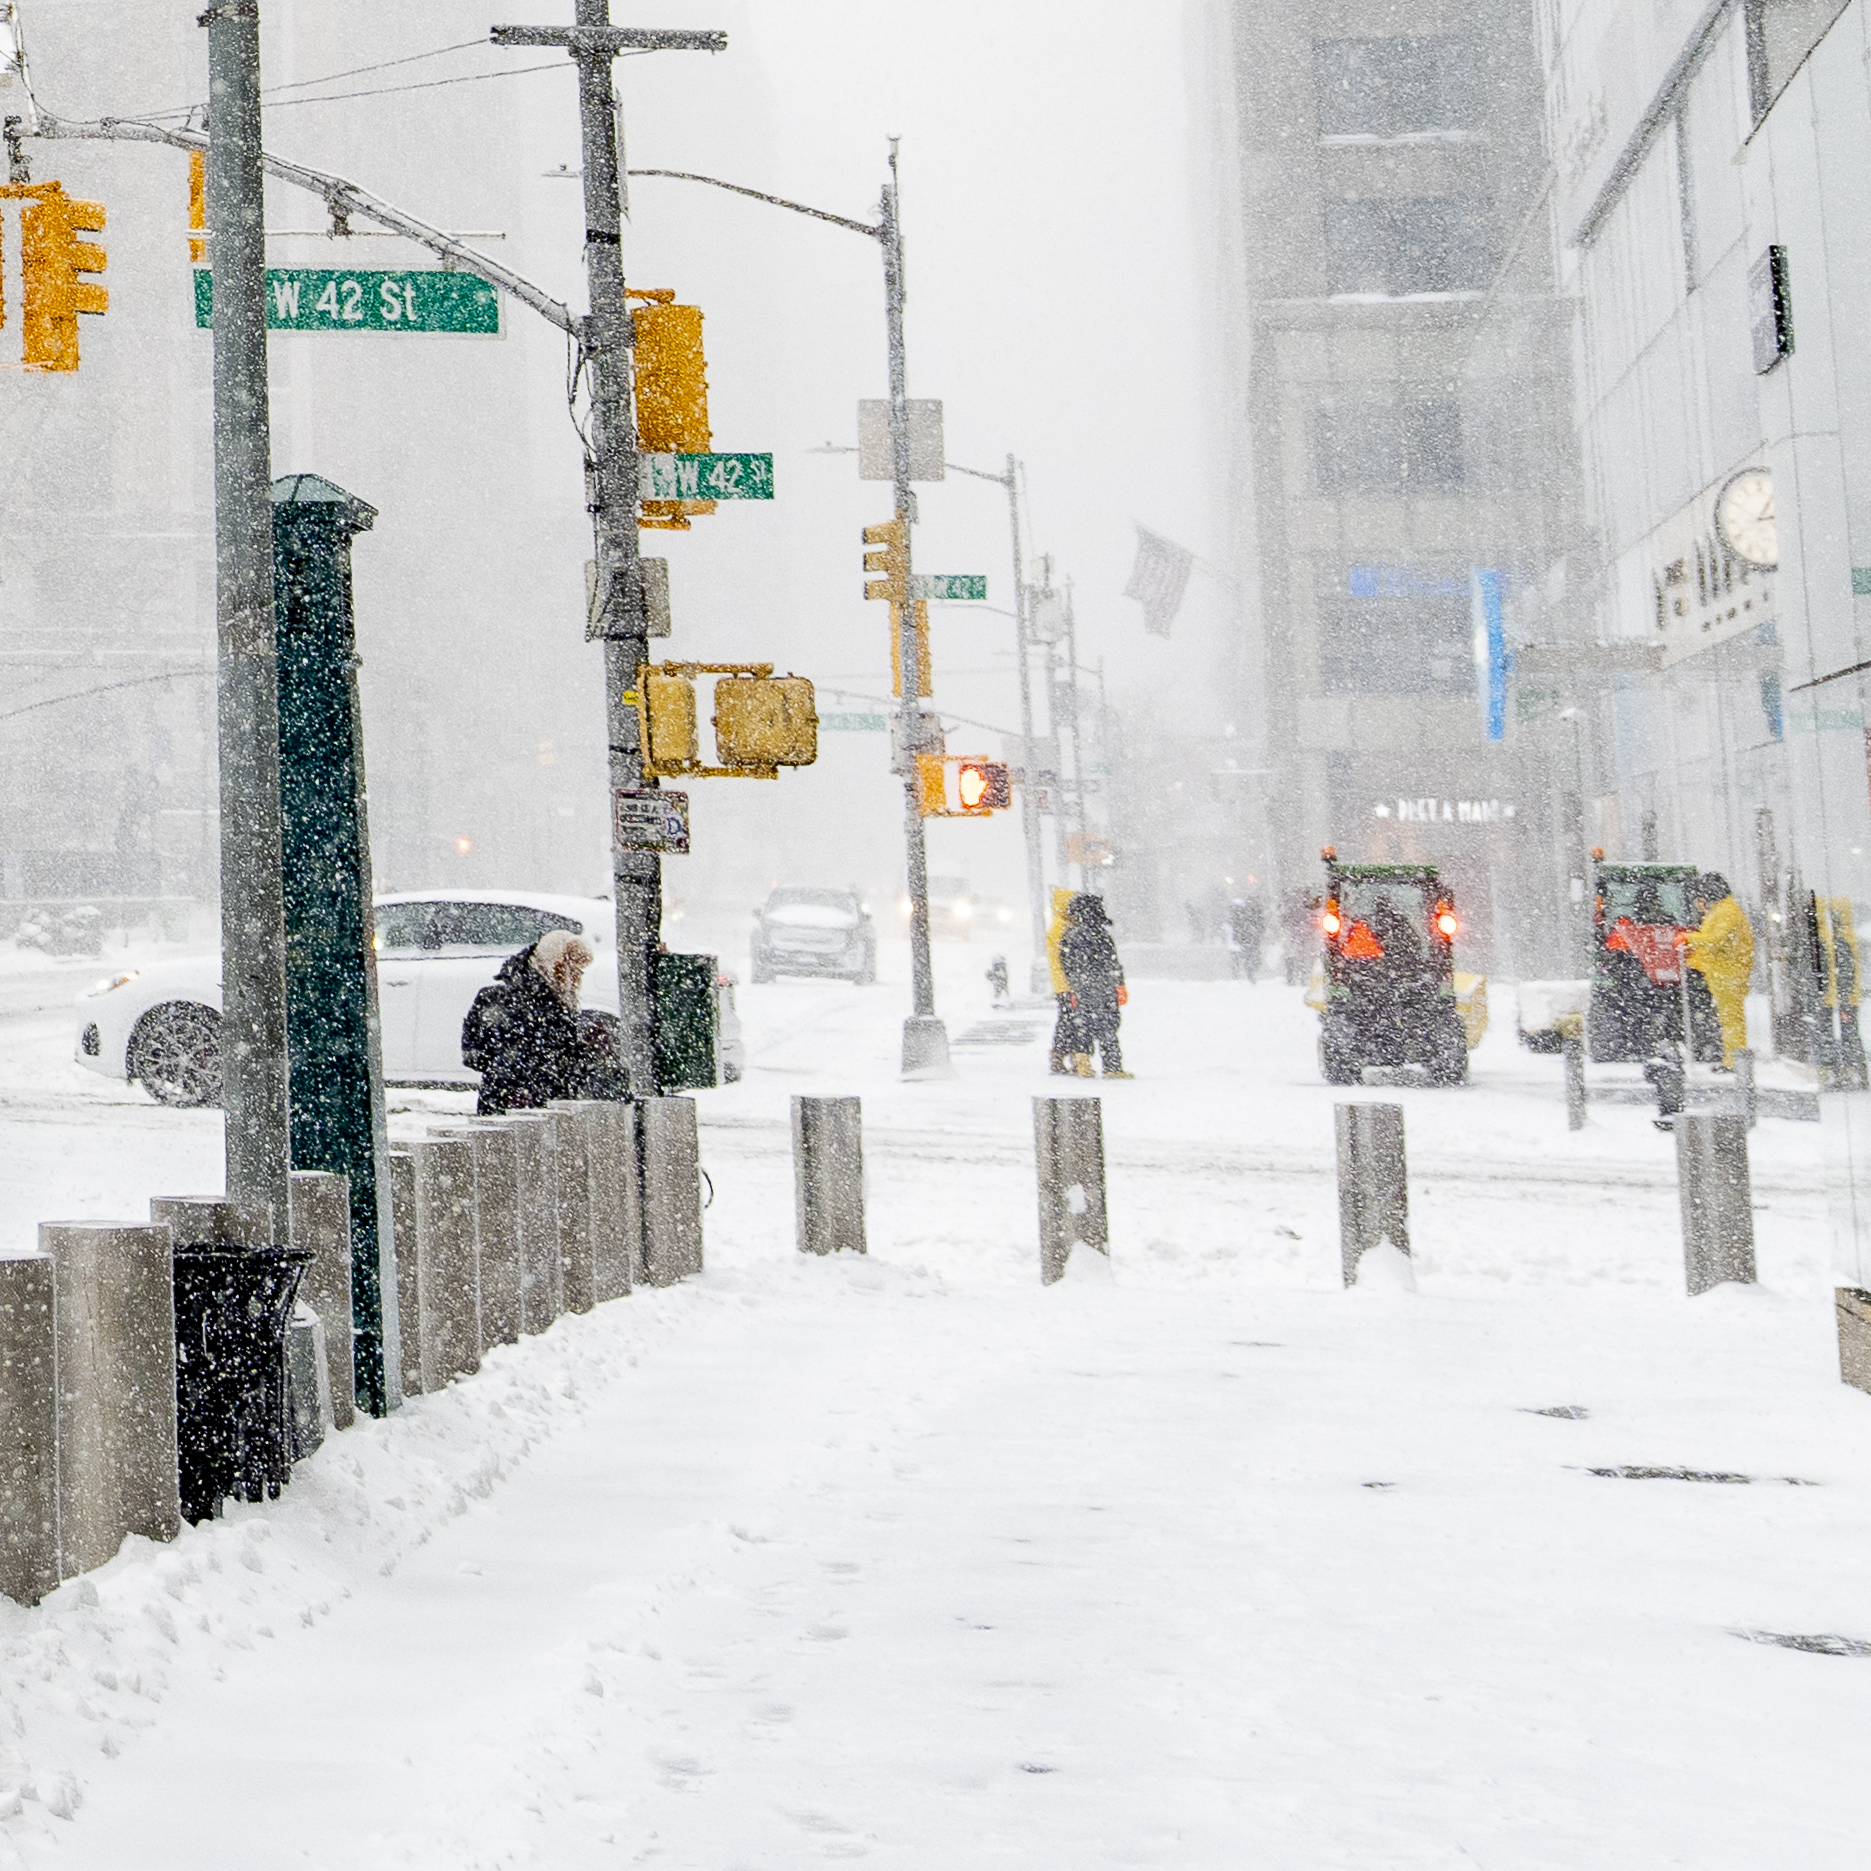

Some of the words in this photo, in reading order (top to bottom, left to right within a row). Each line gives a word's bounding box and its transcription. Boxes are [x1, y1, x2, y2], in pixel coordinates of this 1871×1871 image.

[272, 280, 301, 320] W
[315, 280, 364, 321] 42
[379, 280, 418, 321] St
[676, 459, 699, 493] W
[708, 459, 741, 493] 42
